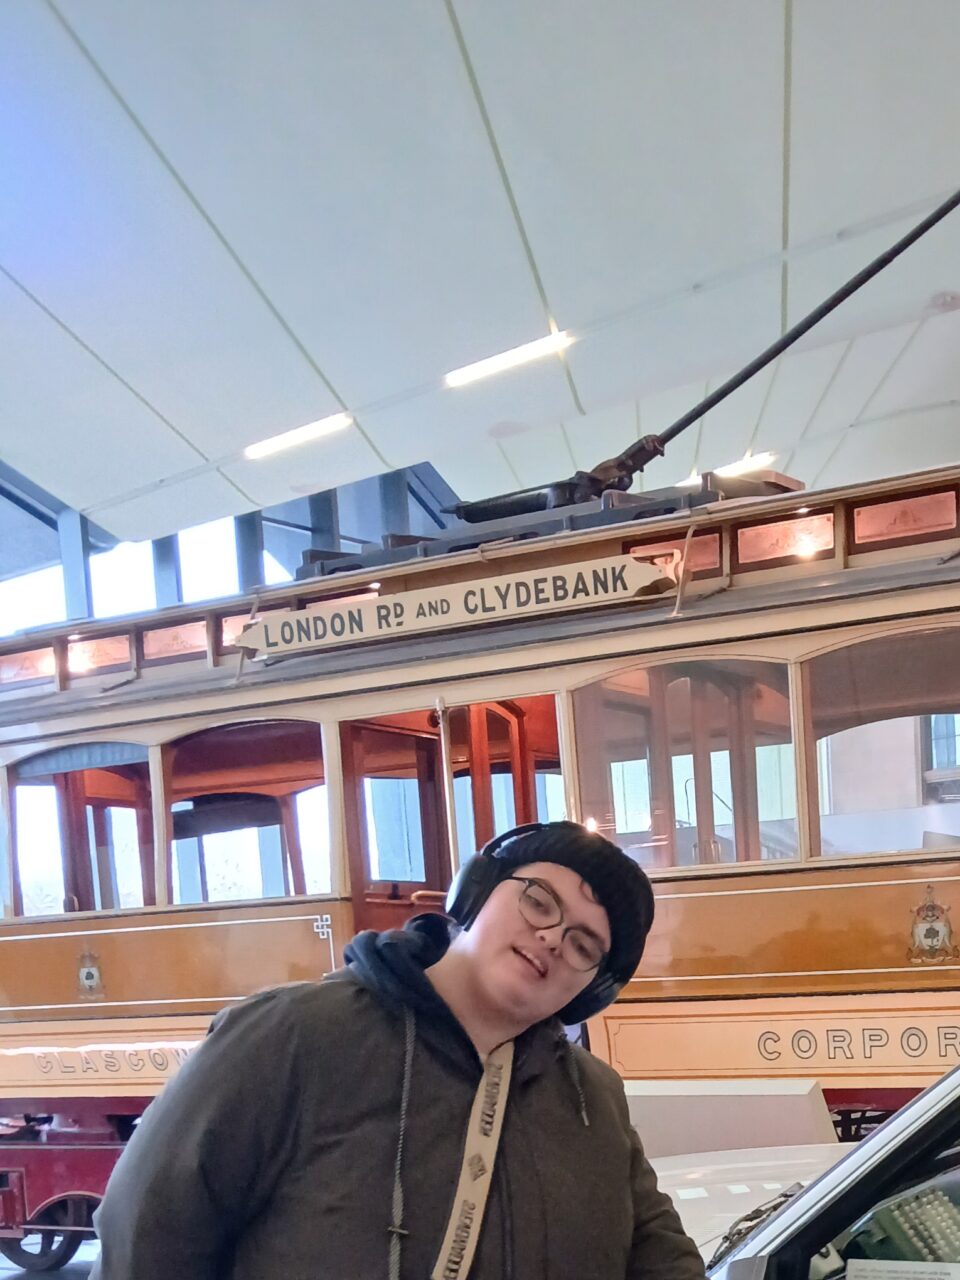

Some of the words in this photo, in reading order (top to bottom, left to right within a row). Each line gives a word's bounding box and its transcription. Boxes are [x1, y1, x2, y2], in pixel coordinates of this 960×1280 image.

[264, 608, 363, 648] LONDON
[416, 598, 451, 617] AND
[463, 564, 629, 615] CLYDEBANK
